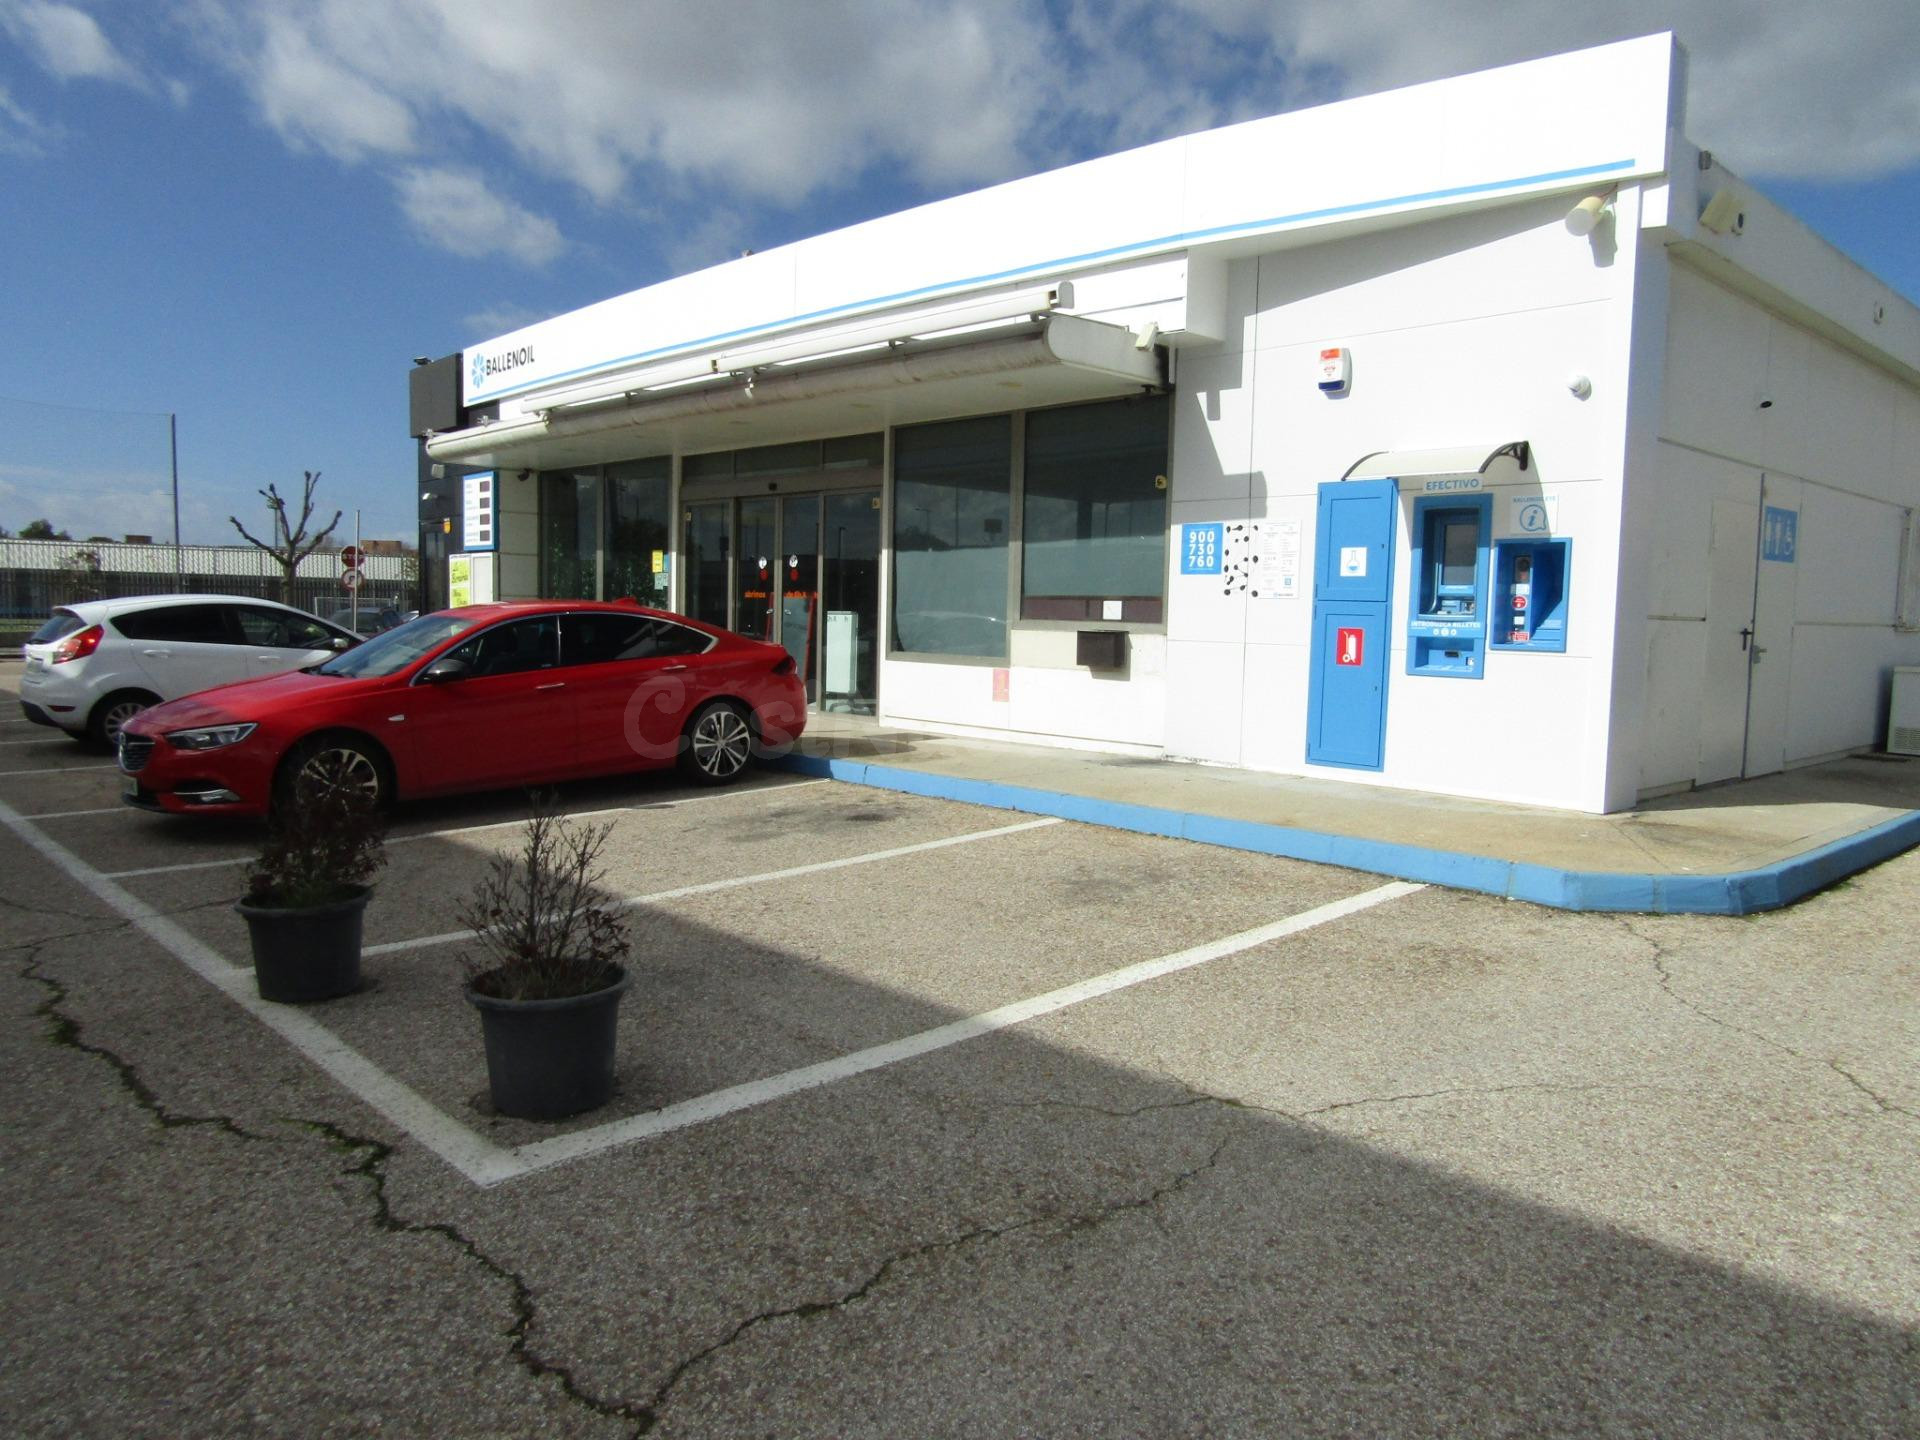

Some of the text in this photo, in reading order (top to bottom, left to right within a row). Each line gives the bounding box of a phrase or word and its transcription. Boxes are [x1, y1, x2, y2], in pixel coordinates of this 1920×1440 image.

[486, 344, 535, 376] BALLENOIL
[1426, 478, 1479, 491] EFECTIVO
[1189, 531, 1215, 543] 900
[1189, 543, 1215, 555] 730
[1188, 555, 1214, 568] 760
